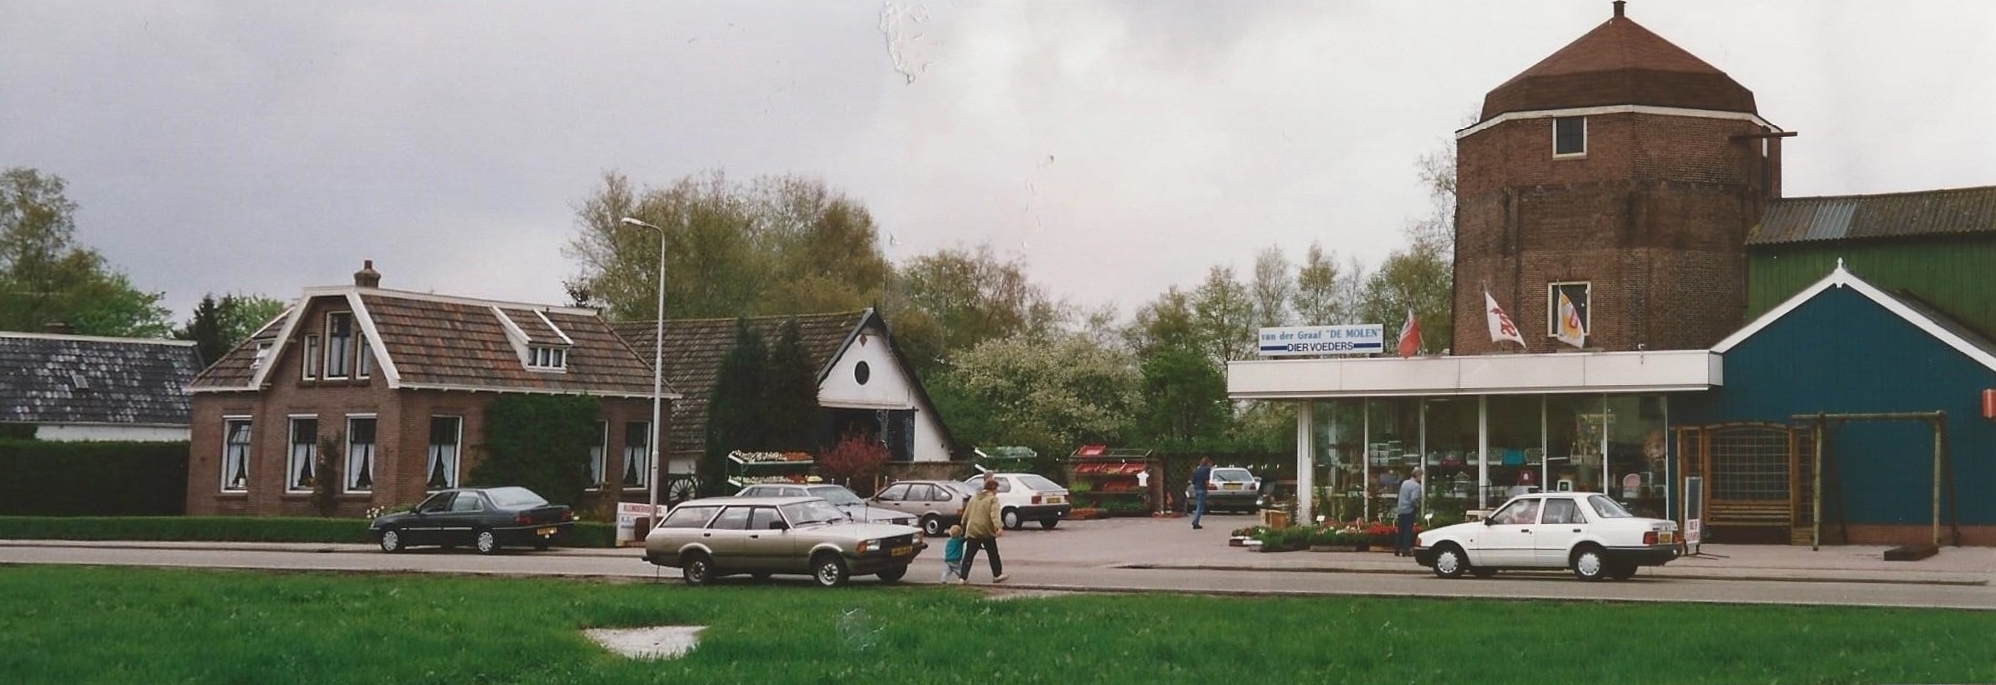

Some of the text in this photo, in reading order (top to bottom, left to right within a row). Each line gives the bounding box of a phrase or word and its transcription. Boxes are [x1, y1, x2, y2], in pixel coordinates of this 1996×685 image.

[1261, 333, 1276, 341] van
[1279, 331, 1293, 340] der
[1297, 330, 1322, 340] Graaf
